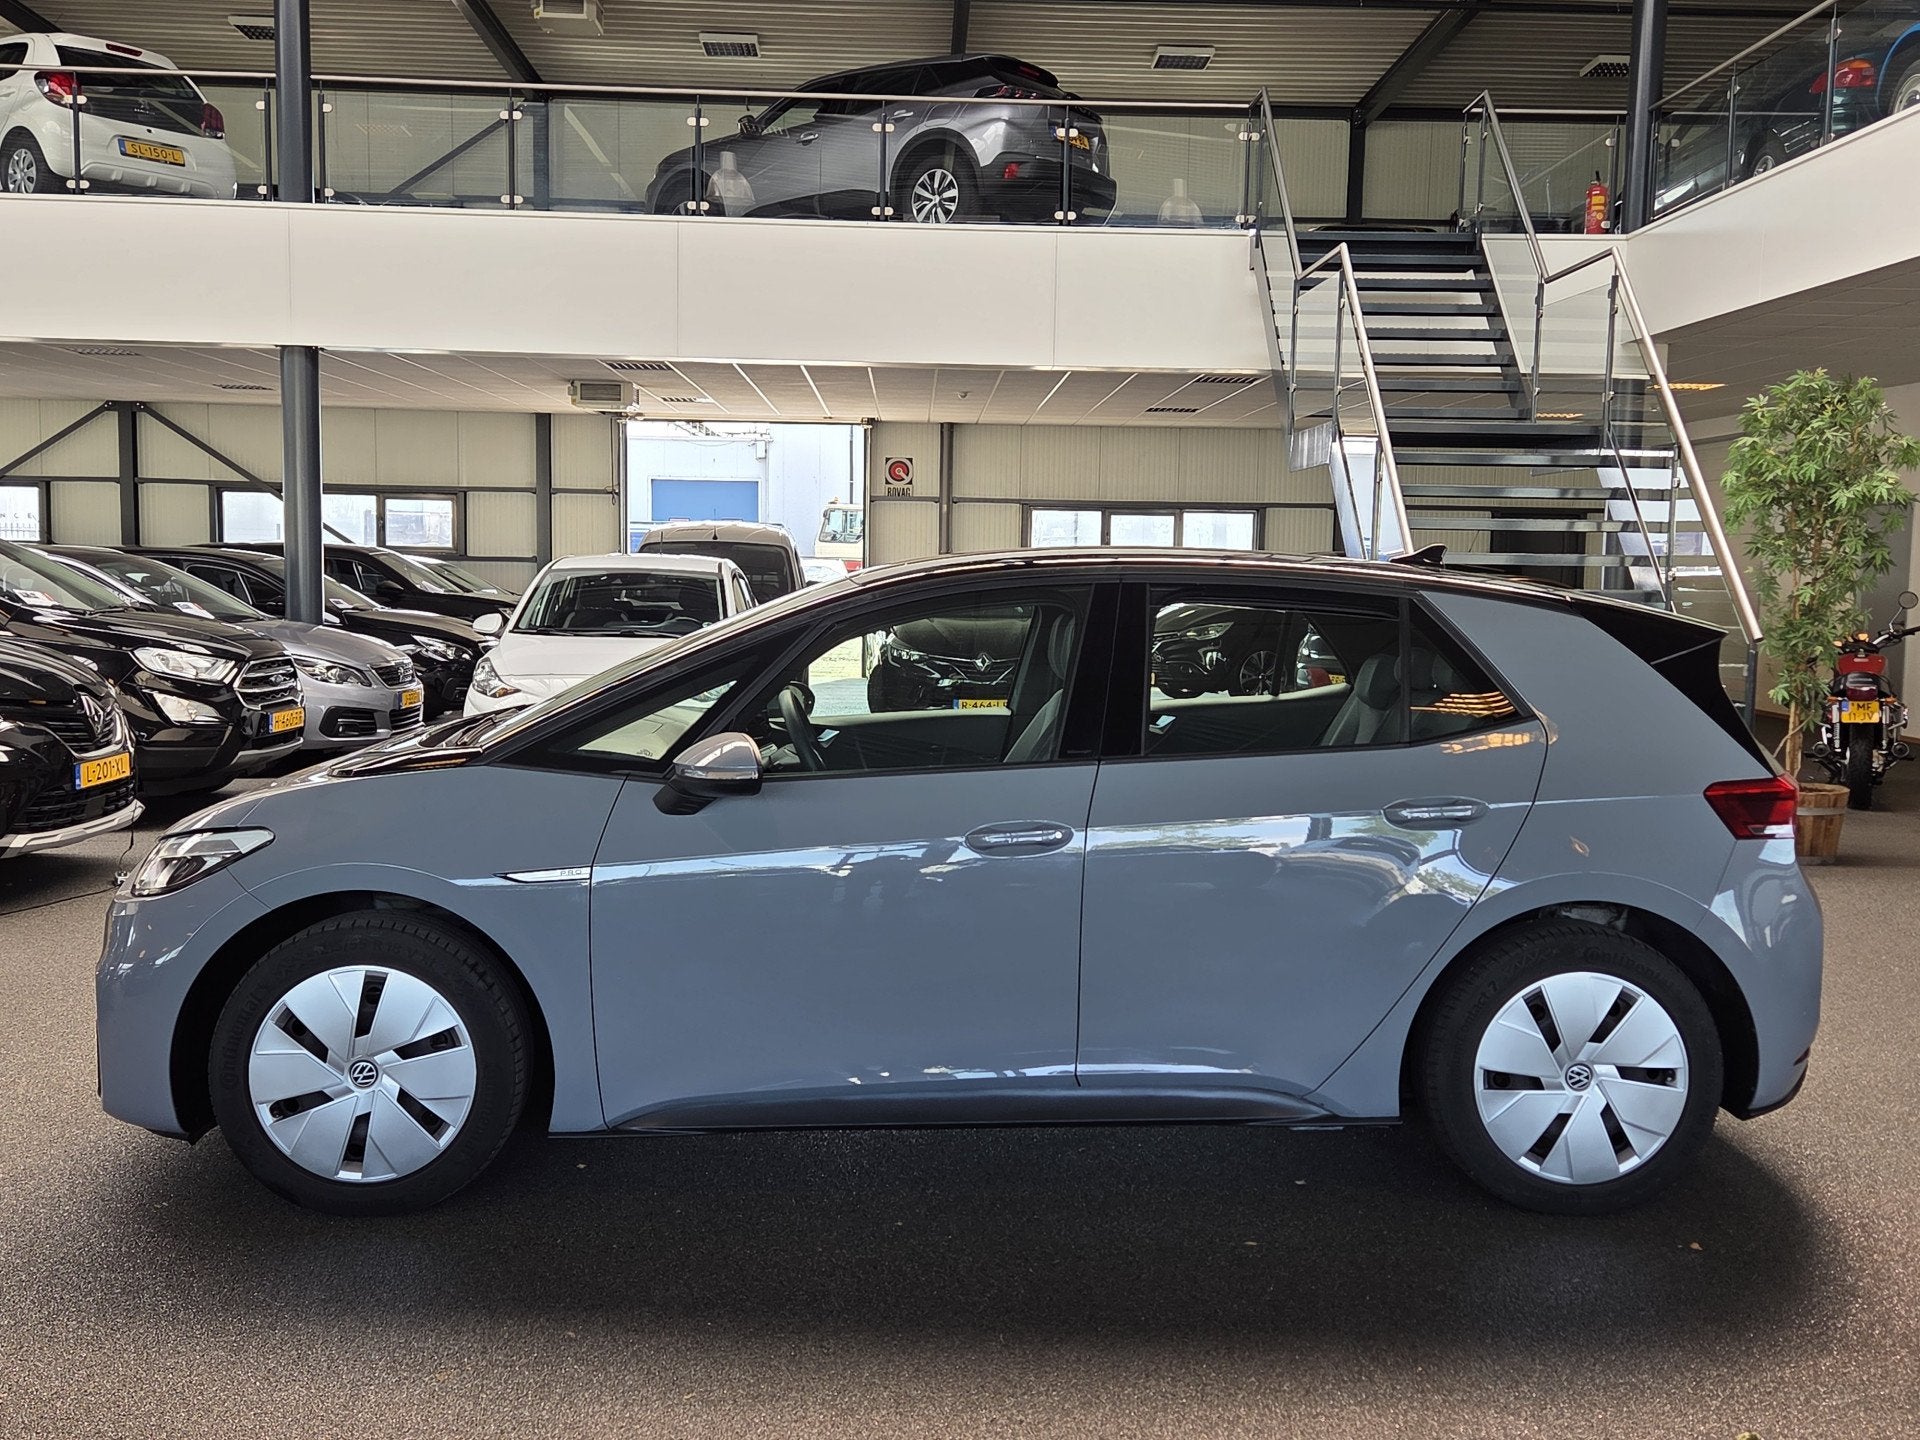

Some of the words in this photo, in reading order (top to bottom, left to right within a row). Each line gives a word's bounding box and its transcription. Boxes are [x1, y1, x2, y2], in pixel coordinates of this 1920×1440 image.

[130, 143, 179, 161] SL-150-L
[86, 757, 127, 783] L-201-XL
[560, 869, 582, 877] PRO
